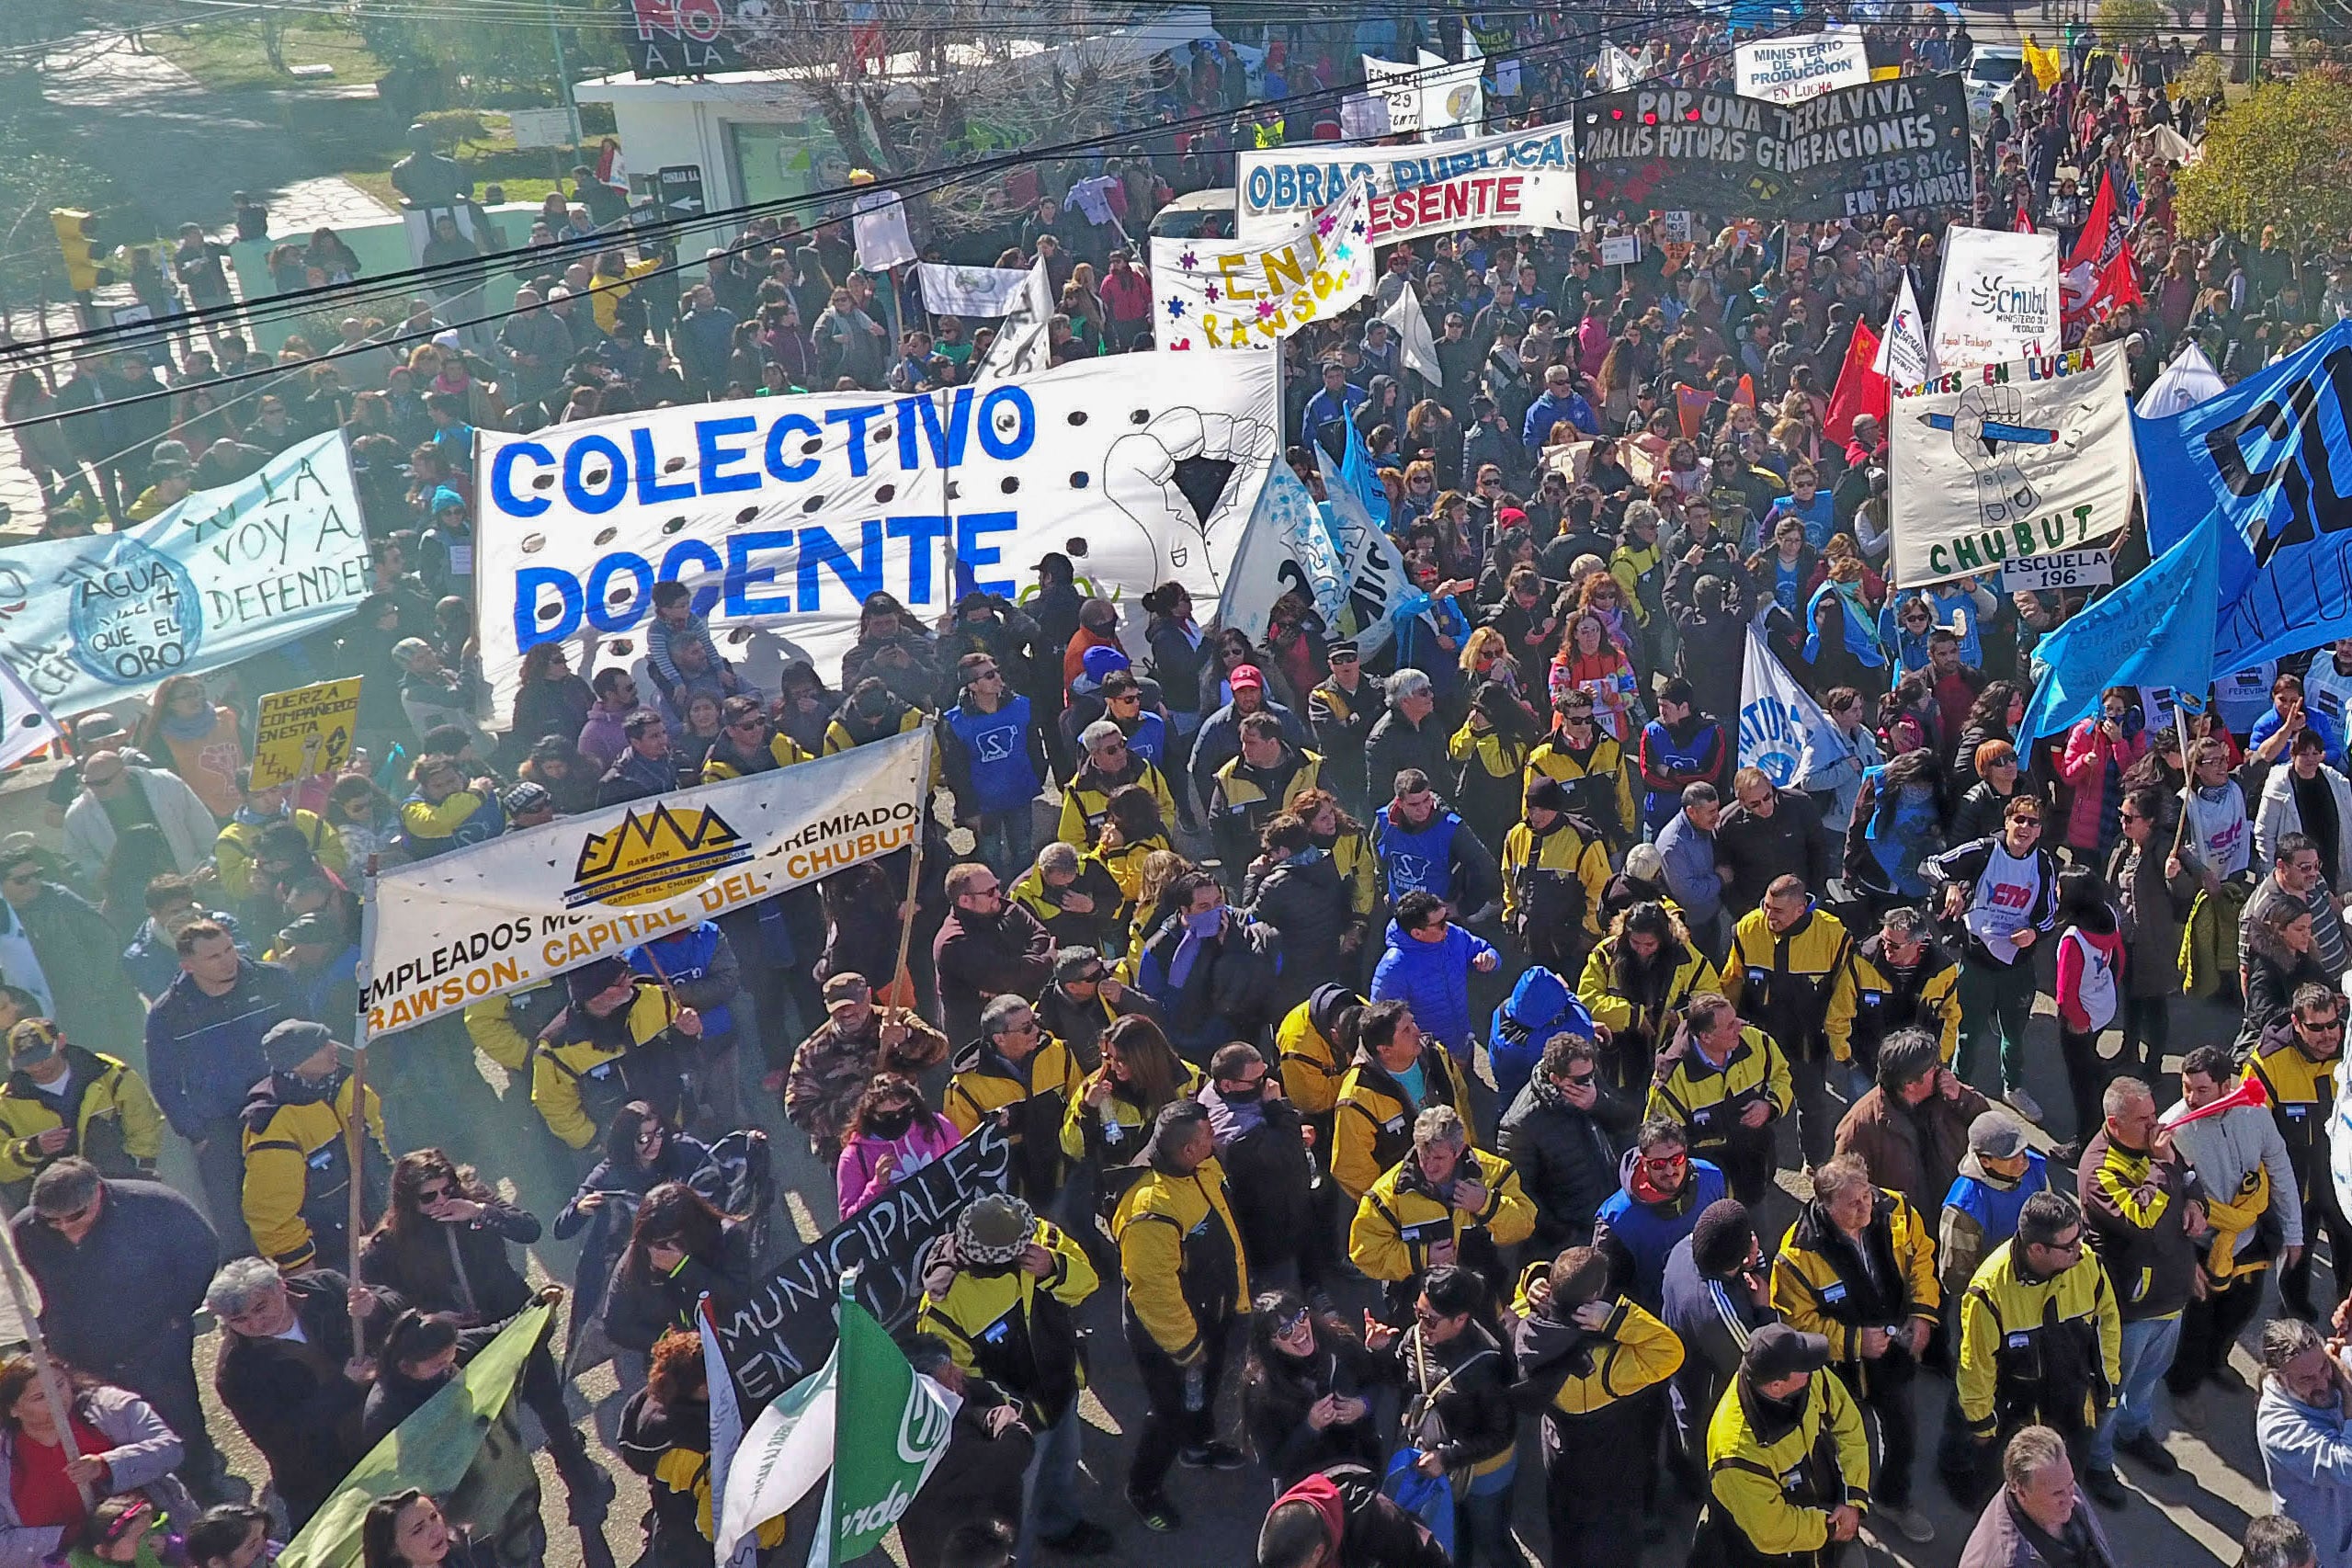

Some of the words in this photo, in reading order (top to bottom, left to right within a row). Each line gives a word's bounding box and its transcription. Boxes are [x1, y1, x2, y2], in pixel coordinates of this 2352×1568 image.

[646, 44, 669, 70] A
[683, 43, 725, 67] LA
[1754, 40, 1844, 62] MINISTERIO
[1772, 60, 1793, 72] DE
[1803, 56, 1825, 67] LA
[1637, 91, 1693, 124] POR
[1701, 95, 1762, 132] UNA
[1846, 83, 1915, 121] VIVA
[1773, 86, 1790, 102] EN
[1794, 81, 1834, 98] LUCHA
[1658, 124, 1747, 163] FUTURAS
[1755, 113, 1937, 174] GENERACIONES
[1861, 157, 1912, 188] IES
[1844, 189, 1878, 217] EN
[1983, 361, 2010, 387] EN
[2028, 347, 2096, 382] LUCHA
[490, 384, 1036, 518] COLECTIVO
[260, 457, 331, 508] LA
[212, 514, 290, 565] VOY
[315, 504, 363, 552] A
[1929, 504, 2094, 575] CHUBUT
[2004, 551, 2108, 574] ESCUELA
[81, 561, 176, 608] AGUA
[515, 510, 1017, 655] DOCENTE
[92, 626, 136, 653] QUE
[153, 618, 180, 637] EL
[115, 642, 186, 679] ORO
[263, 687, 338, 713] FUERZA
[622, 866, 682, 885] MUNICIPALES
[627, 850, 670, 869] RAWSON
[542, 906, 686, 969] CAPITAL
[697, 872, 767, 913] DEL
[787, 824, 915, 881] CHUBUT
[608, 891, 642, 906] CAPITAL
[645, 885, 665, 895] DEL
[667, 873, 707, 891] CHUBUT
[358, 915, 532, 1014] EMPLEADOS
[717, 1122, 1009, 1353] MUNICIPALES
[736, 1331, 803, 1399] EN
